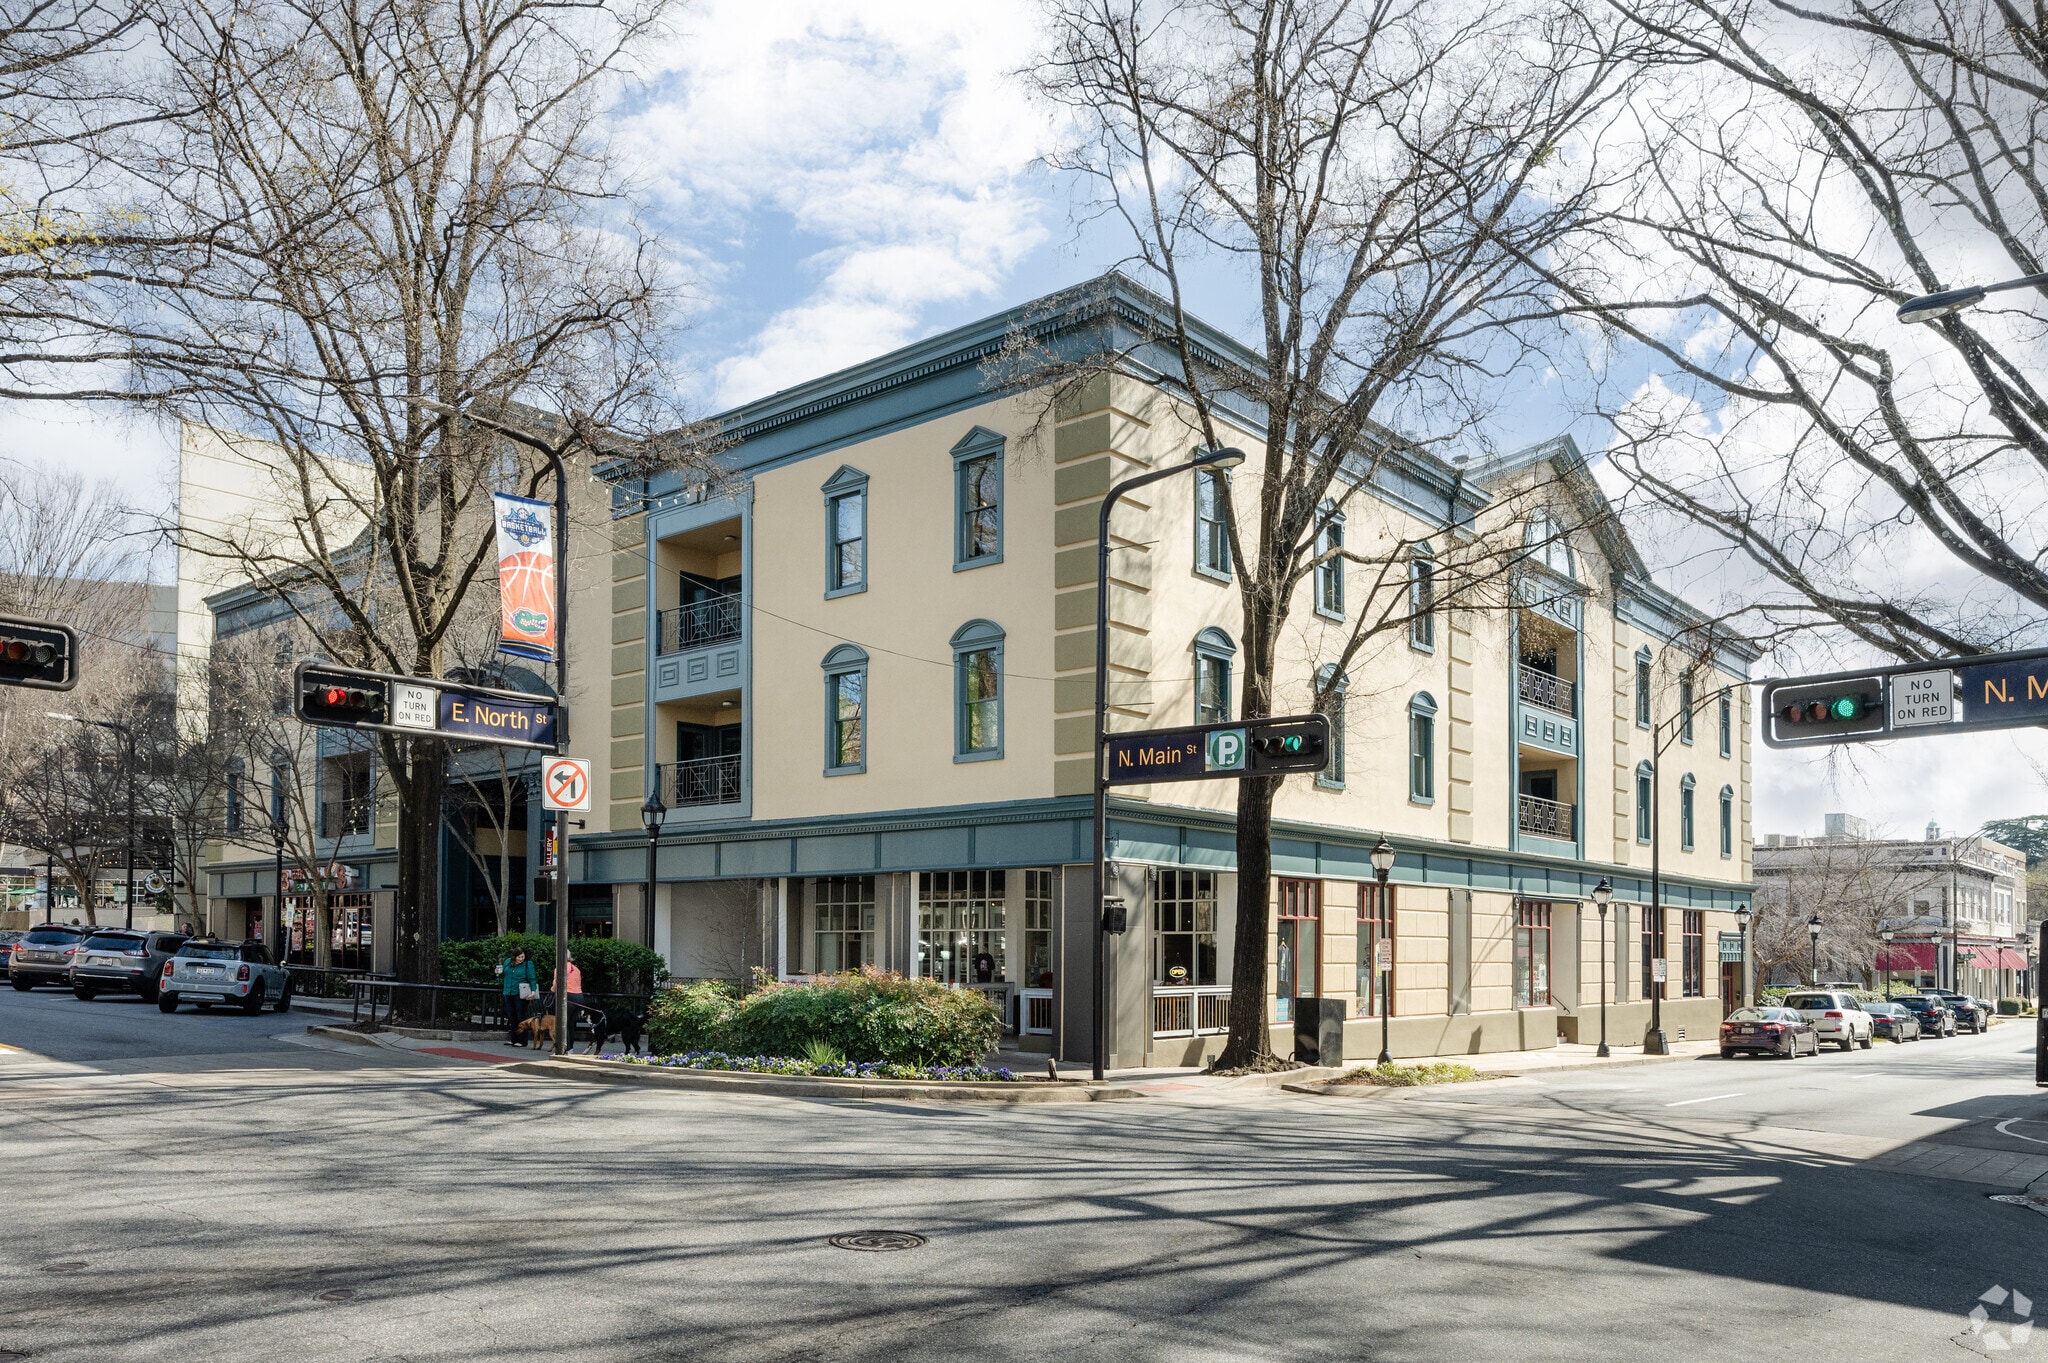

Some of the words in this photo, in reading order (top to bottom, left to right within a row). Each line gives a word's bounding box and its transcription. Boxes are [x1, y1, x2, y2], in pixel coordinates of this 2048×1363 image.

[501, 520, 546, 536] BASKETBALL
[1910, 679, 1932, 691] NO
[1984, 678, 2015, 704] N.
[407, 690, 423, 700] NO
[1904, 691, 1940, 705] TURN
[403, 700, 427, 711] TURN
[1897, 708, 1916, 720] ON
[1922, 705, 1948, 717] RED
[398, 711, 411, 721] ON
[414, 713, 432, 723] RED
[452, 702, 470, 723] E.
[475, 705, 529, 730] North
[535, 713, 548, 725] St
[1118, 749, 1134, 767] N.
[1139, 746, 1182, 766] Main
[1186, 744, 1198, 755] St
[1218, 735, 1240, 765] P
